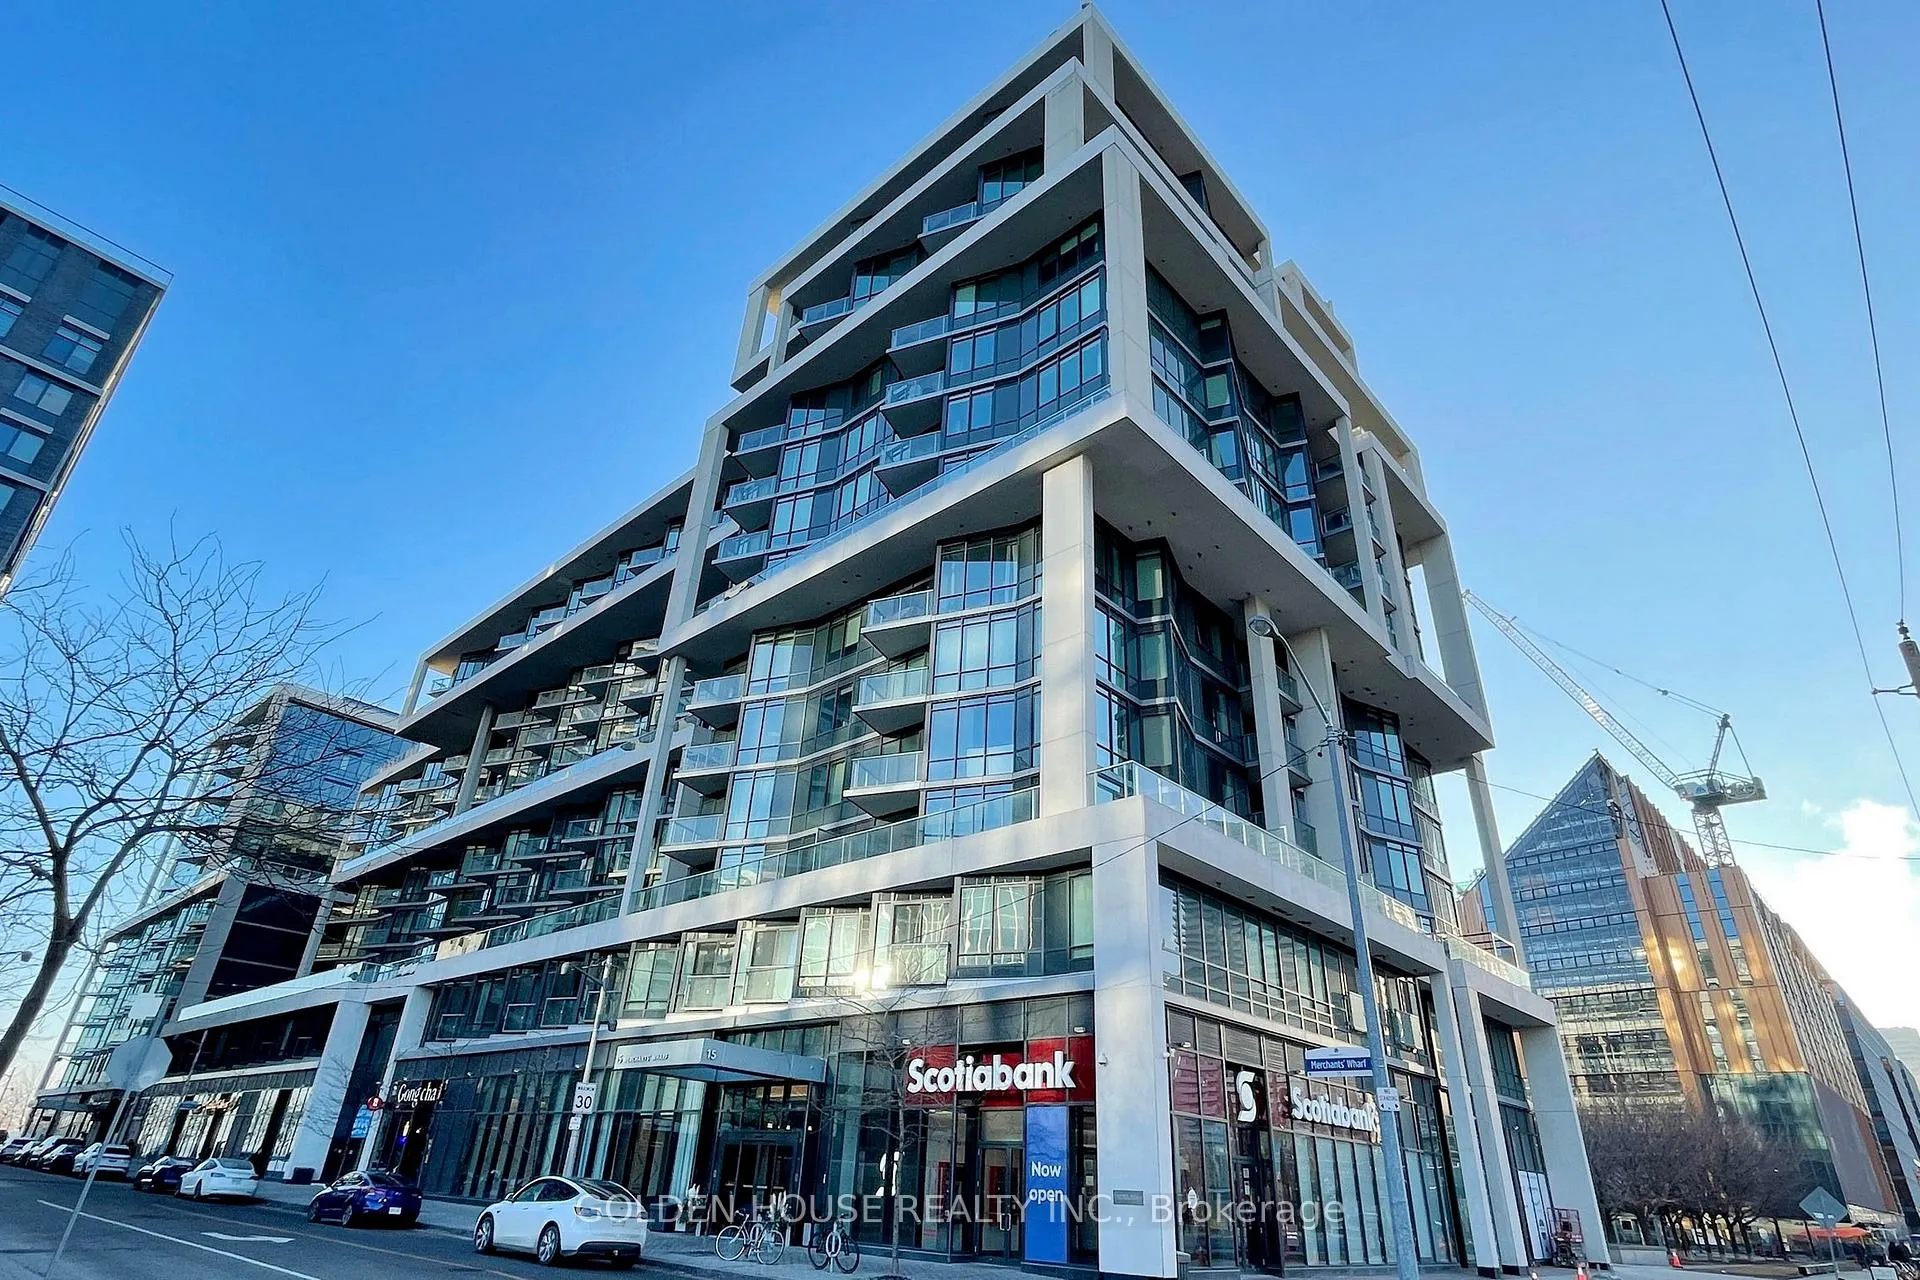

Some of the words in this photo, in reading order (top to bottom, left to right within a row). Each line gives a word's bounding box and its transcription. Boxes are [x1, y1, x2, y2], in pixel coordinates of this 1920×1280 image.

[707, 1049, 717, 1060] 15
[906, 1050, 1077, 1094] Scotiabank
[1310, 1059, 1345, 1070] Merchants'
[1346, 1058, 1367, 1069] Wharf
[397, 1083, 421, 1109] Gong
[575, 1095, 592, 1109] 30
[1031, 1161, 1062, 1178] Now
[1029, 1188, 1064, 1204] open
